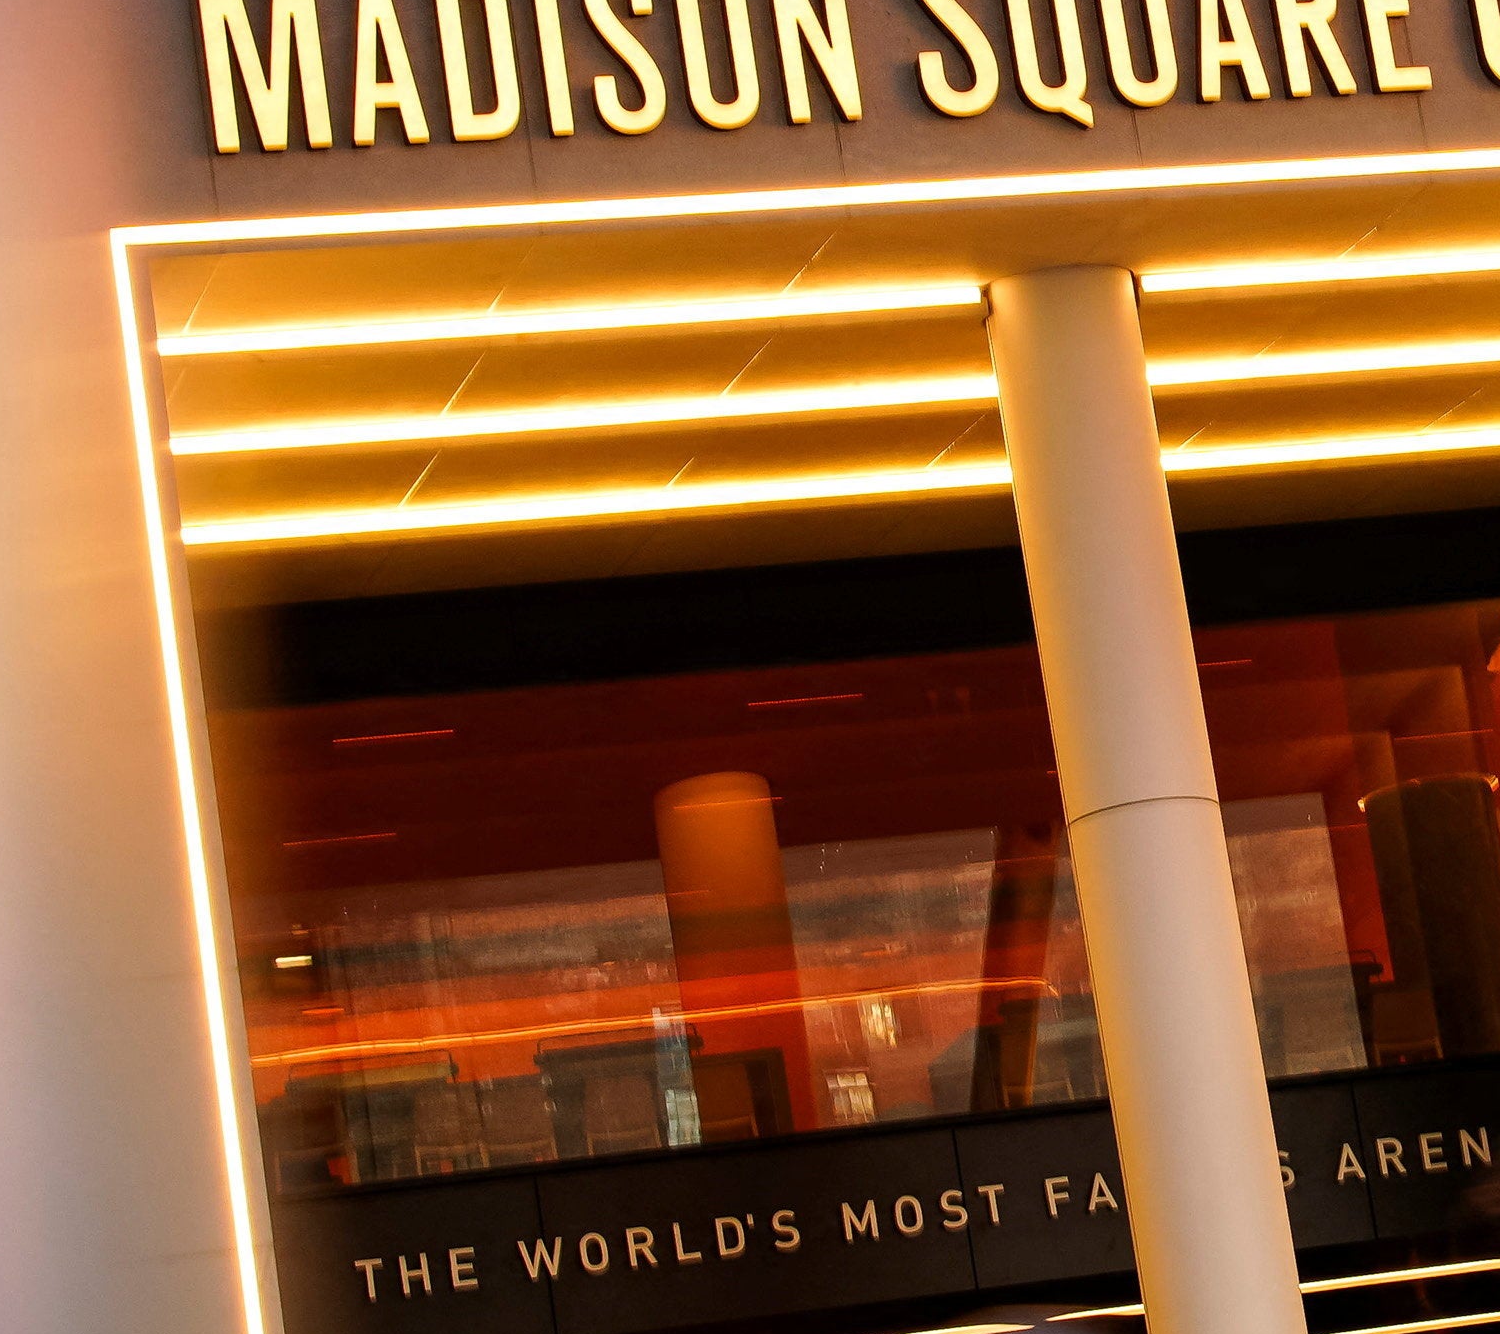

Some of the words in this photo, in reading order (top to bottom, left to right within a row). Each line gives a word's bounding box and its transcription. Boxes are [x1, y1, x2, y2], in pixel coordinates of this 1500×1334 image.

[355, 1246, 479, 1303] THE
[517, 1209, 801, 1282] WORLD'S
[842, 1183, 1007, 1247] MOST
